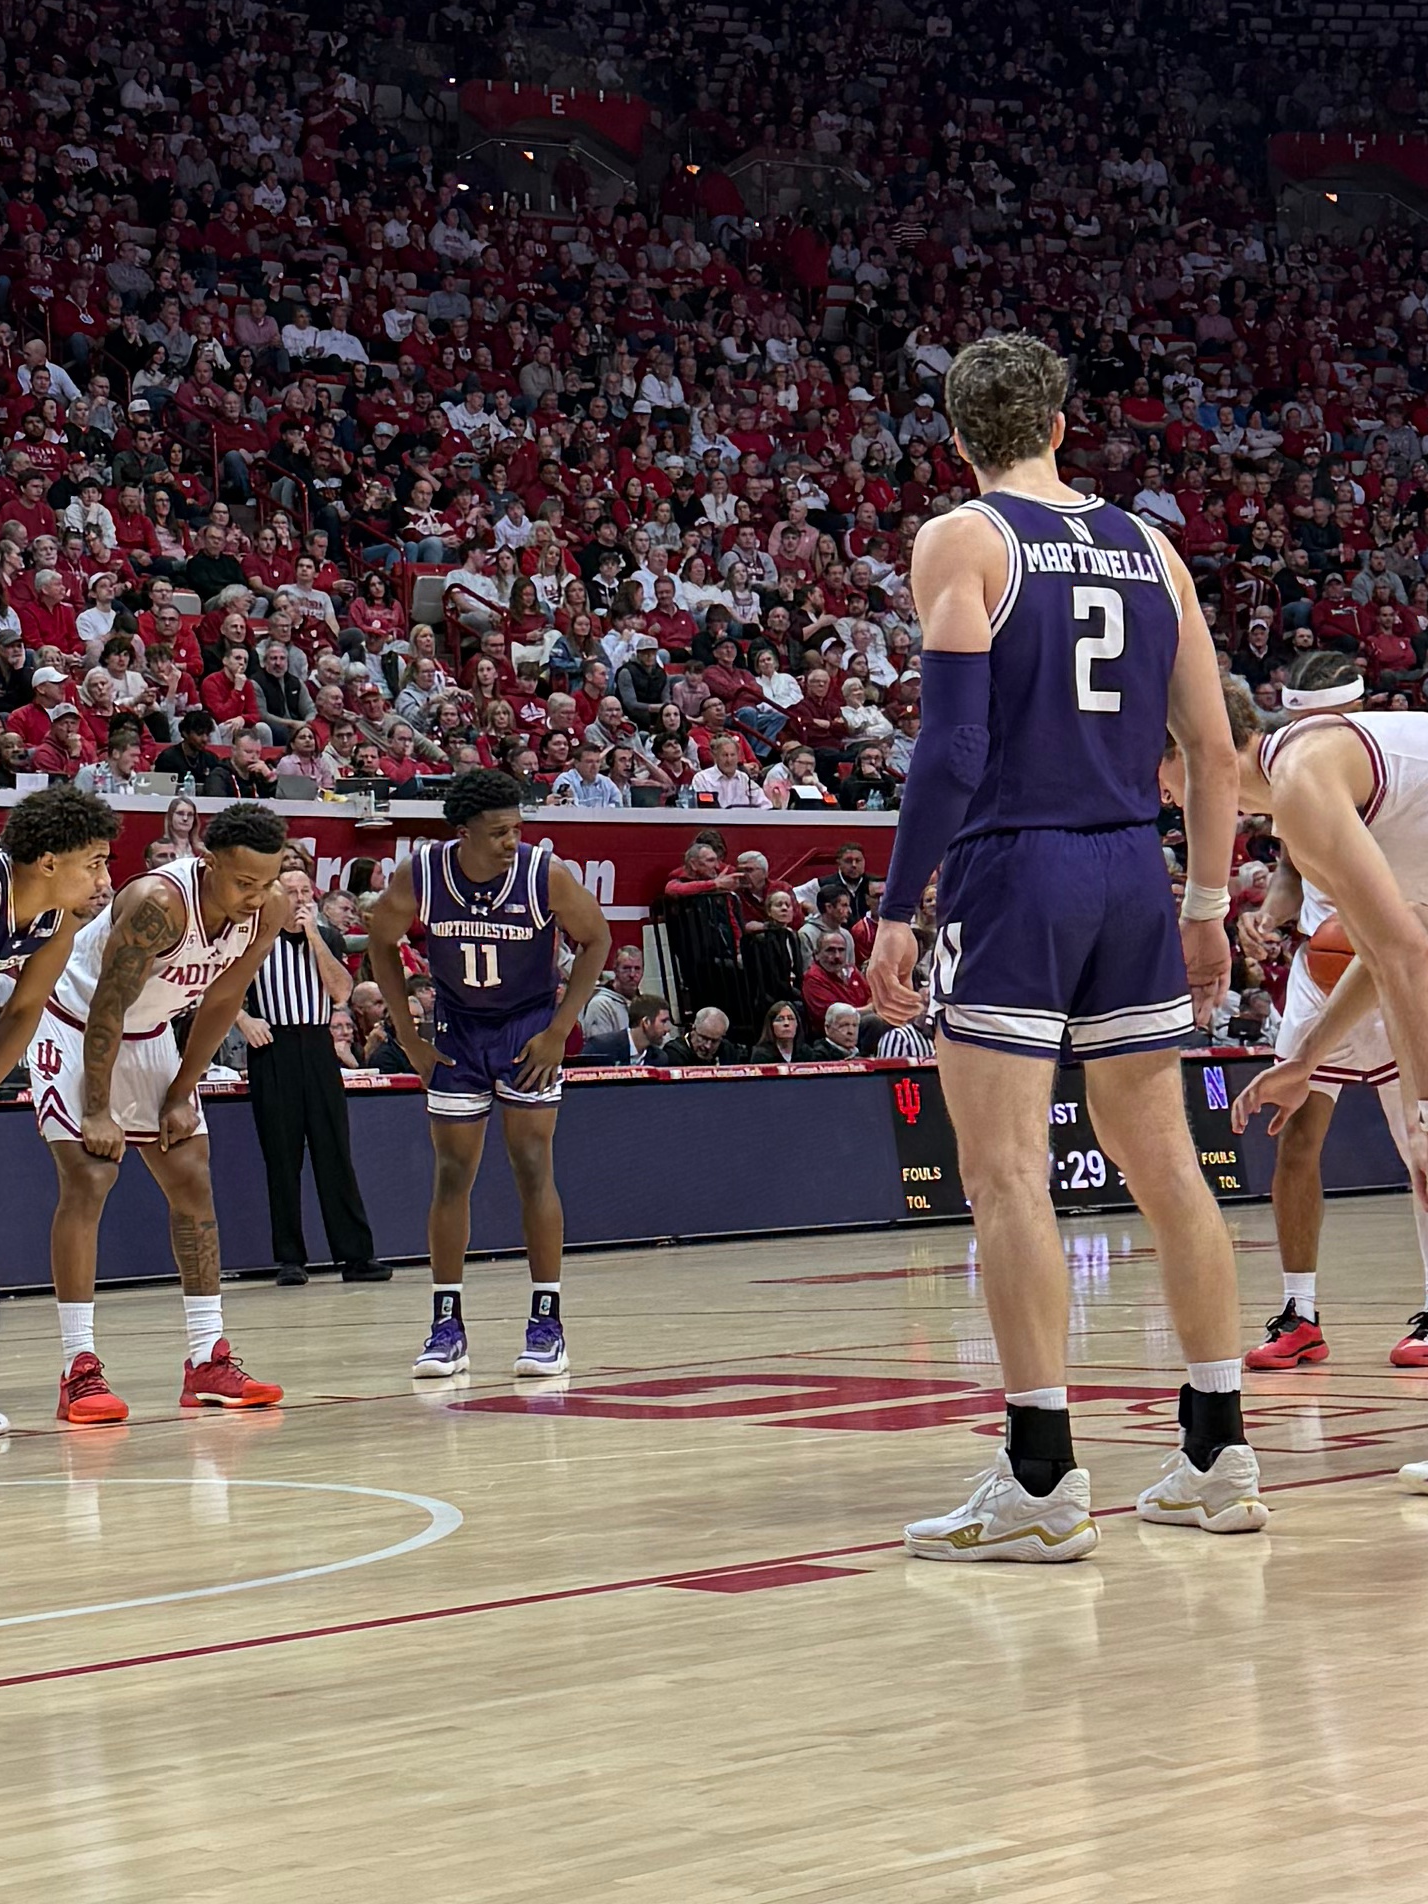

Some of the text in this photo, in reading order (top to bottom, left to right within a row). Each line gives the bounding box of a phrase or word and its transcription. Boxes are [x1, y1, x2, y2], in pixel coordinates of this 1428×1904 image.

[551, 94, 565, 115] E
[1354, 140, 1367, 159] F
[1022, 542, 1159, 583] MARTINELLI
[1072, 585, 1124, 712] 2
[431, 921, 533, 941] NORTHWESTERN
[460, 942, 502, 988] 11
[1201, 1150, 1237, 1166] FOULS
[902, 1166, 942, 1183] FOULS
[1218, 1174, 1241, 1190] TOL
[906, 1195, 932, 1210] TOL
